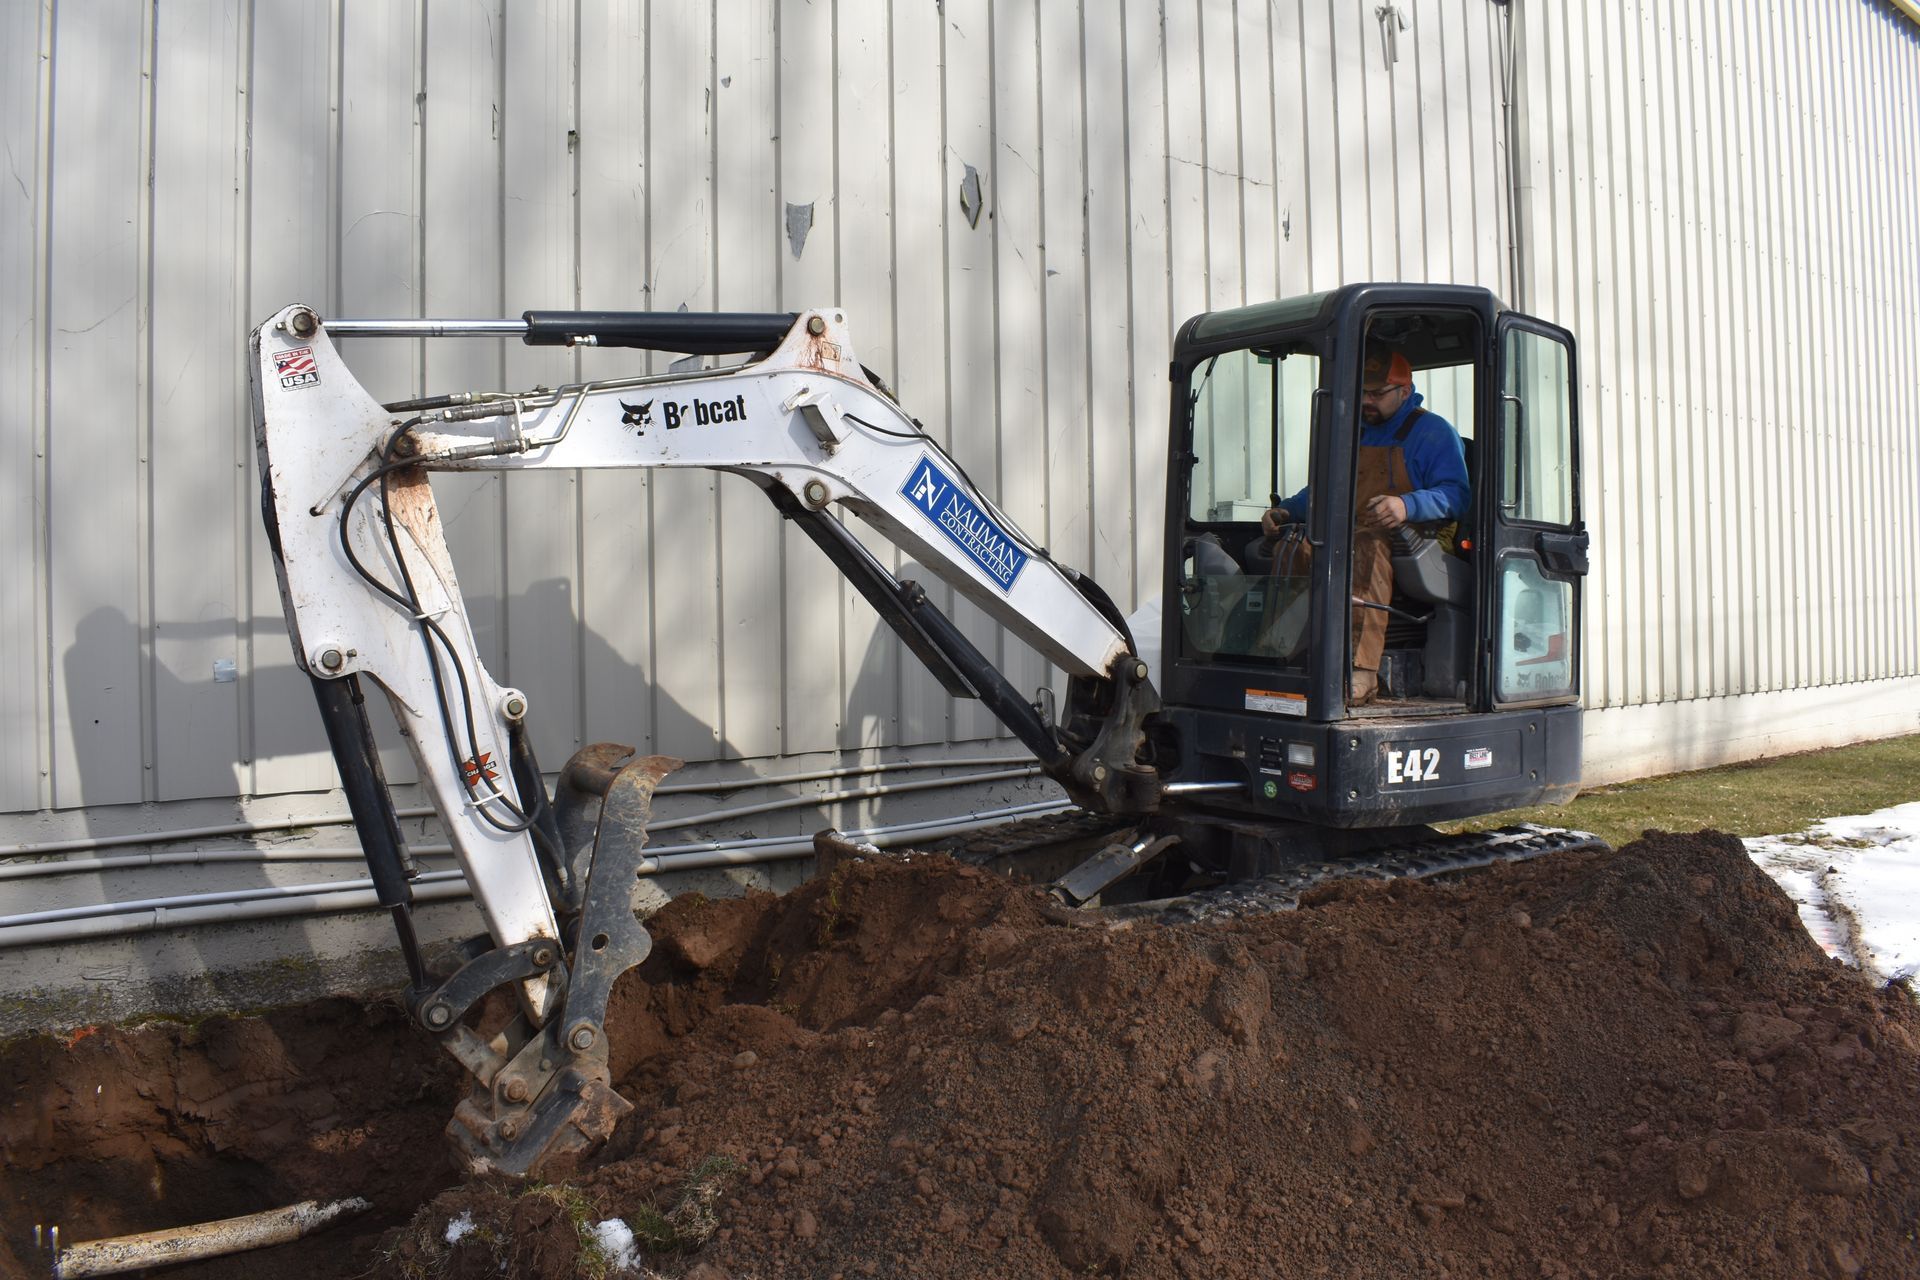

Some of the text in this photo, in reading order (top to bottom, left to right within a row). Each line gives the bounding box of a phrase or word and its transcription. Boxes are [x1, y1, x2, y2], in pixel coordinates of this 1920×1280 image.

[282, 373, 316, 386] USA
[940, 511, 1013, 582] CONTRACTING
[946, 493, 1021, 571] NAUMAN
[466, 760, 495, 777] CHAGE
[1387, 747, 1441, 784] E42
